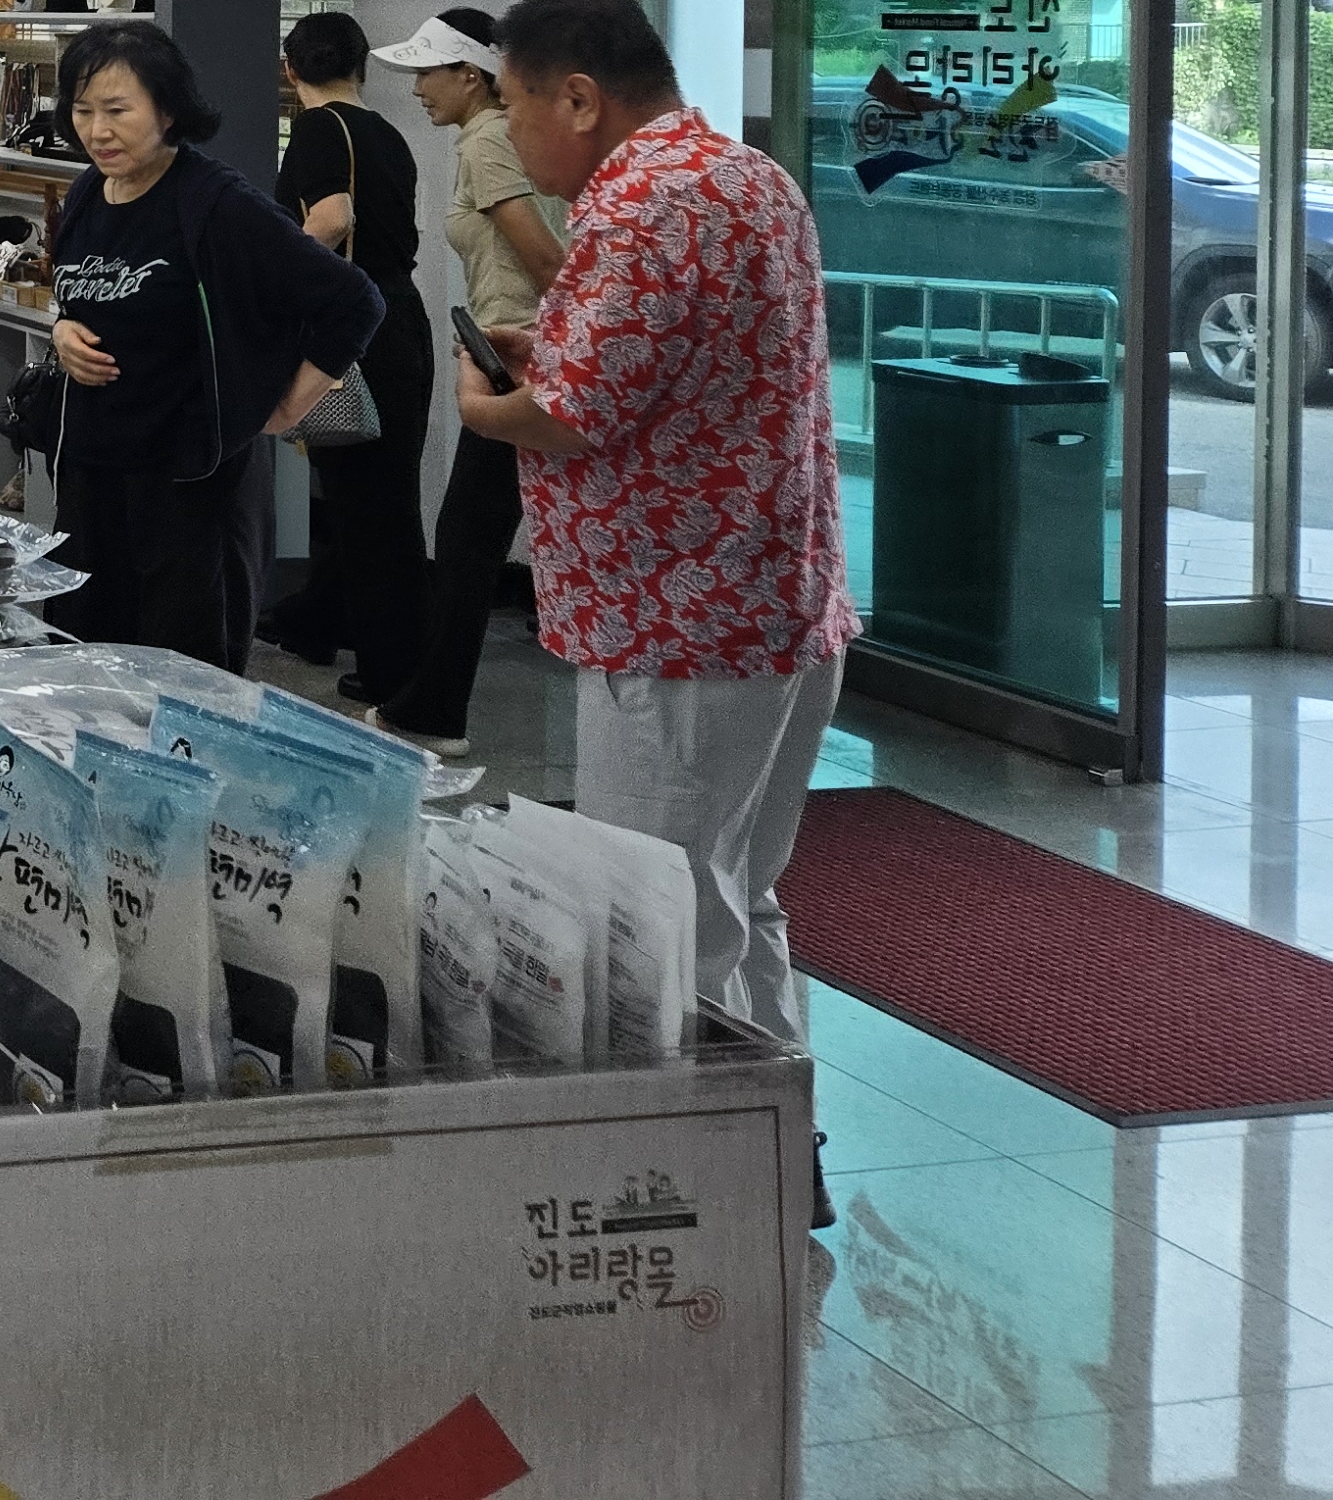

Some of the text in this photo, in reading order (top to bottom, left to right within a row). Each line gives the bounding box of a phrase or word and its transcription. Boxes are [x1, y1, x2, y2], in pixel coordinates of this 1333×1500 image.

[53, 258, 171, 303] Traveler
[524, 1197, 598, 1239] 진도
[523, 1243, 695, 1310] 아리랑몰
